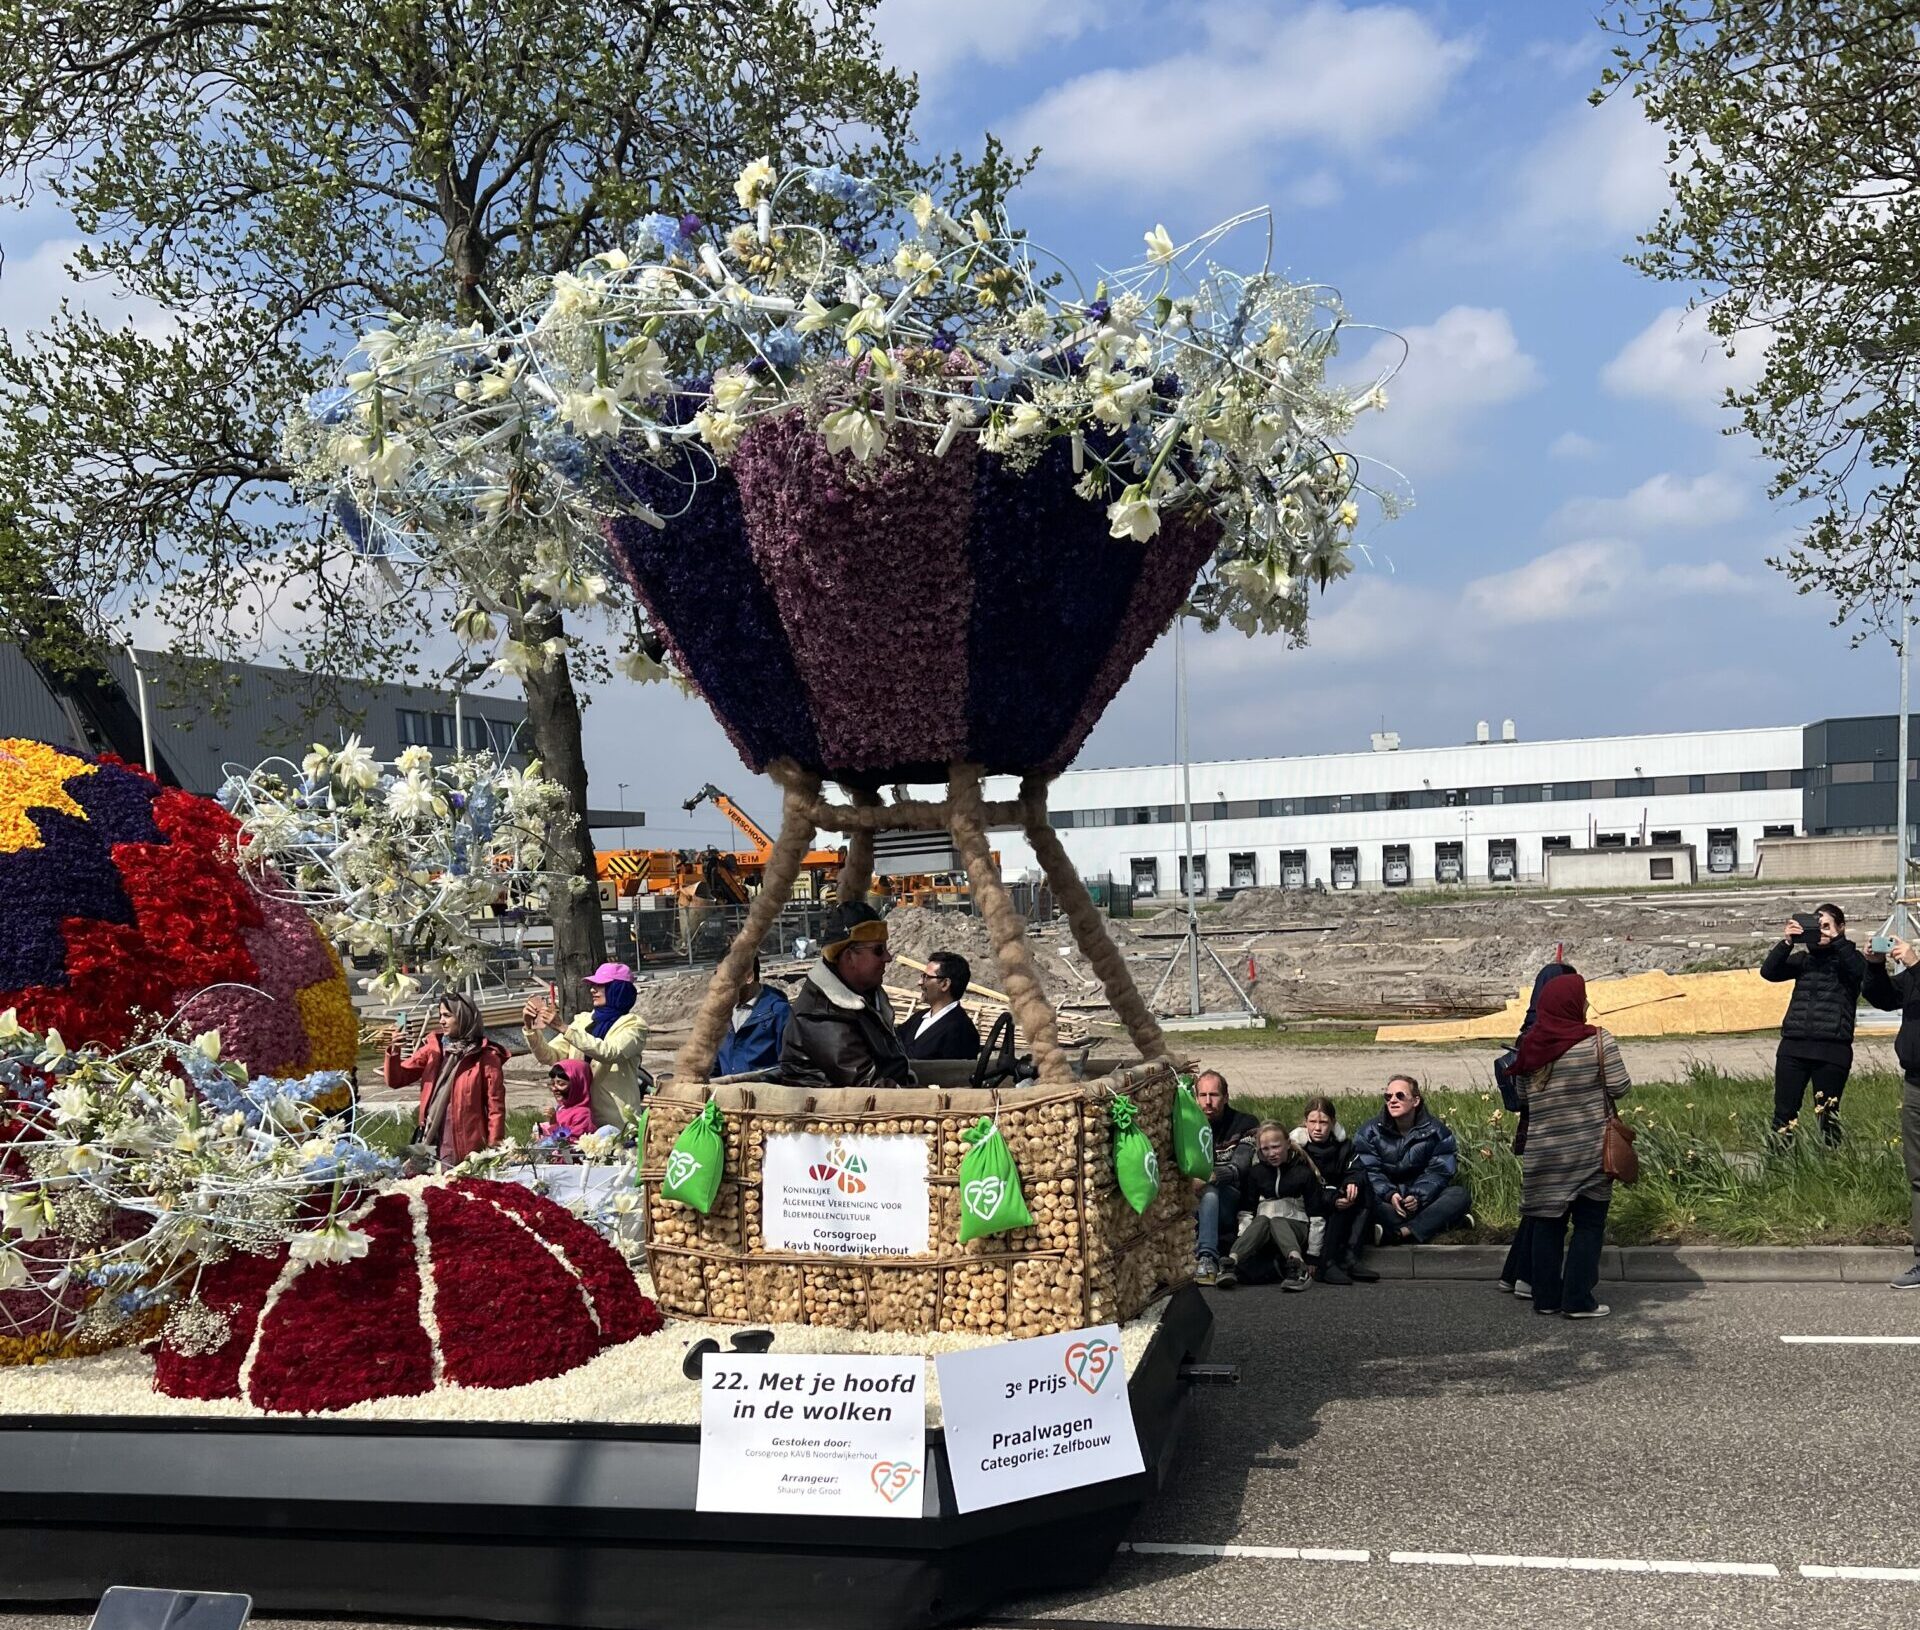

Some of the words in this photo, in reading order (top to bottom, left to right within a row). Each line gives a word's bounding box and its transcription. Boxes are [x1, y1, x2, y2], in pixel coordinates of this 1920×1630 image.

[728, 808, 767, 848] VERSCHOOR
[813, 1228, 877, 1241] Corsogroep
[784, 1241, 810, 1251] Kavb
[813, 1241, 909, 1255] Noordwijkerhout
[712, 1372, 749, 1390] 22.
[759, 1373, 804, 1391] Met
[809, 1372, 836, 1396] je
[843, 1374, 916, 1393] hoofd
[1028, 1374, 1067, 1395] Prijs
[733, 1400, 756, 1419] in
[764, 1401, 794, 1420] de
[803, 1402, 892, 1421] wolken
[992, 1417, 1093, 1449] Praalwagen
[772, 1437, 820, 1447] Gestoken
[823, 1439, 852, 1448] door:
[745, 1449, 788, 1459] Corsogroep
[790, 1450, 811, 1458] KAVB
[813, 1451, 878, 1461] Noordwijkerhout
[981, 1447, 1049, 1471] Categorie:
[1053, 1434, 1111, 1456] Zelfbouw
[781, 1473, 839, 1484] Arrangeur:
[807, 1487, 817, 1495] de
[819, 1487, 841, 1495] Groot
